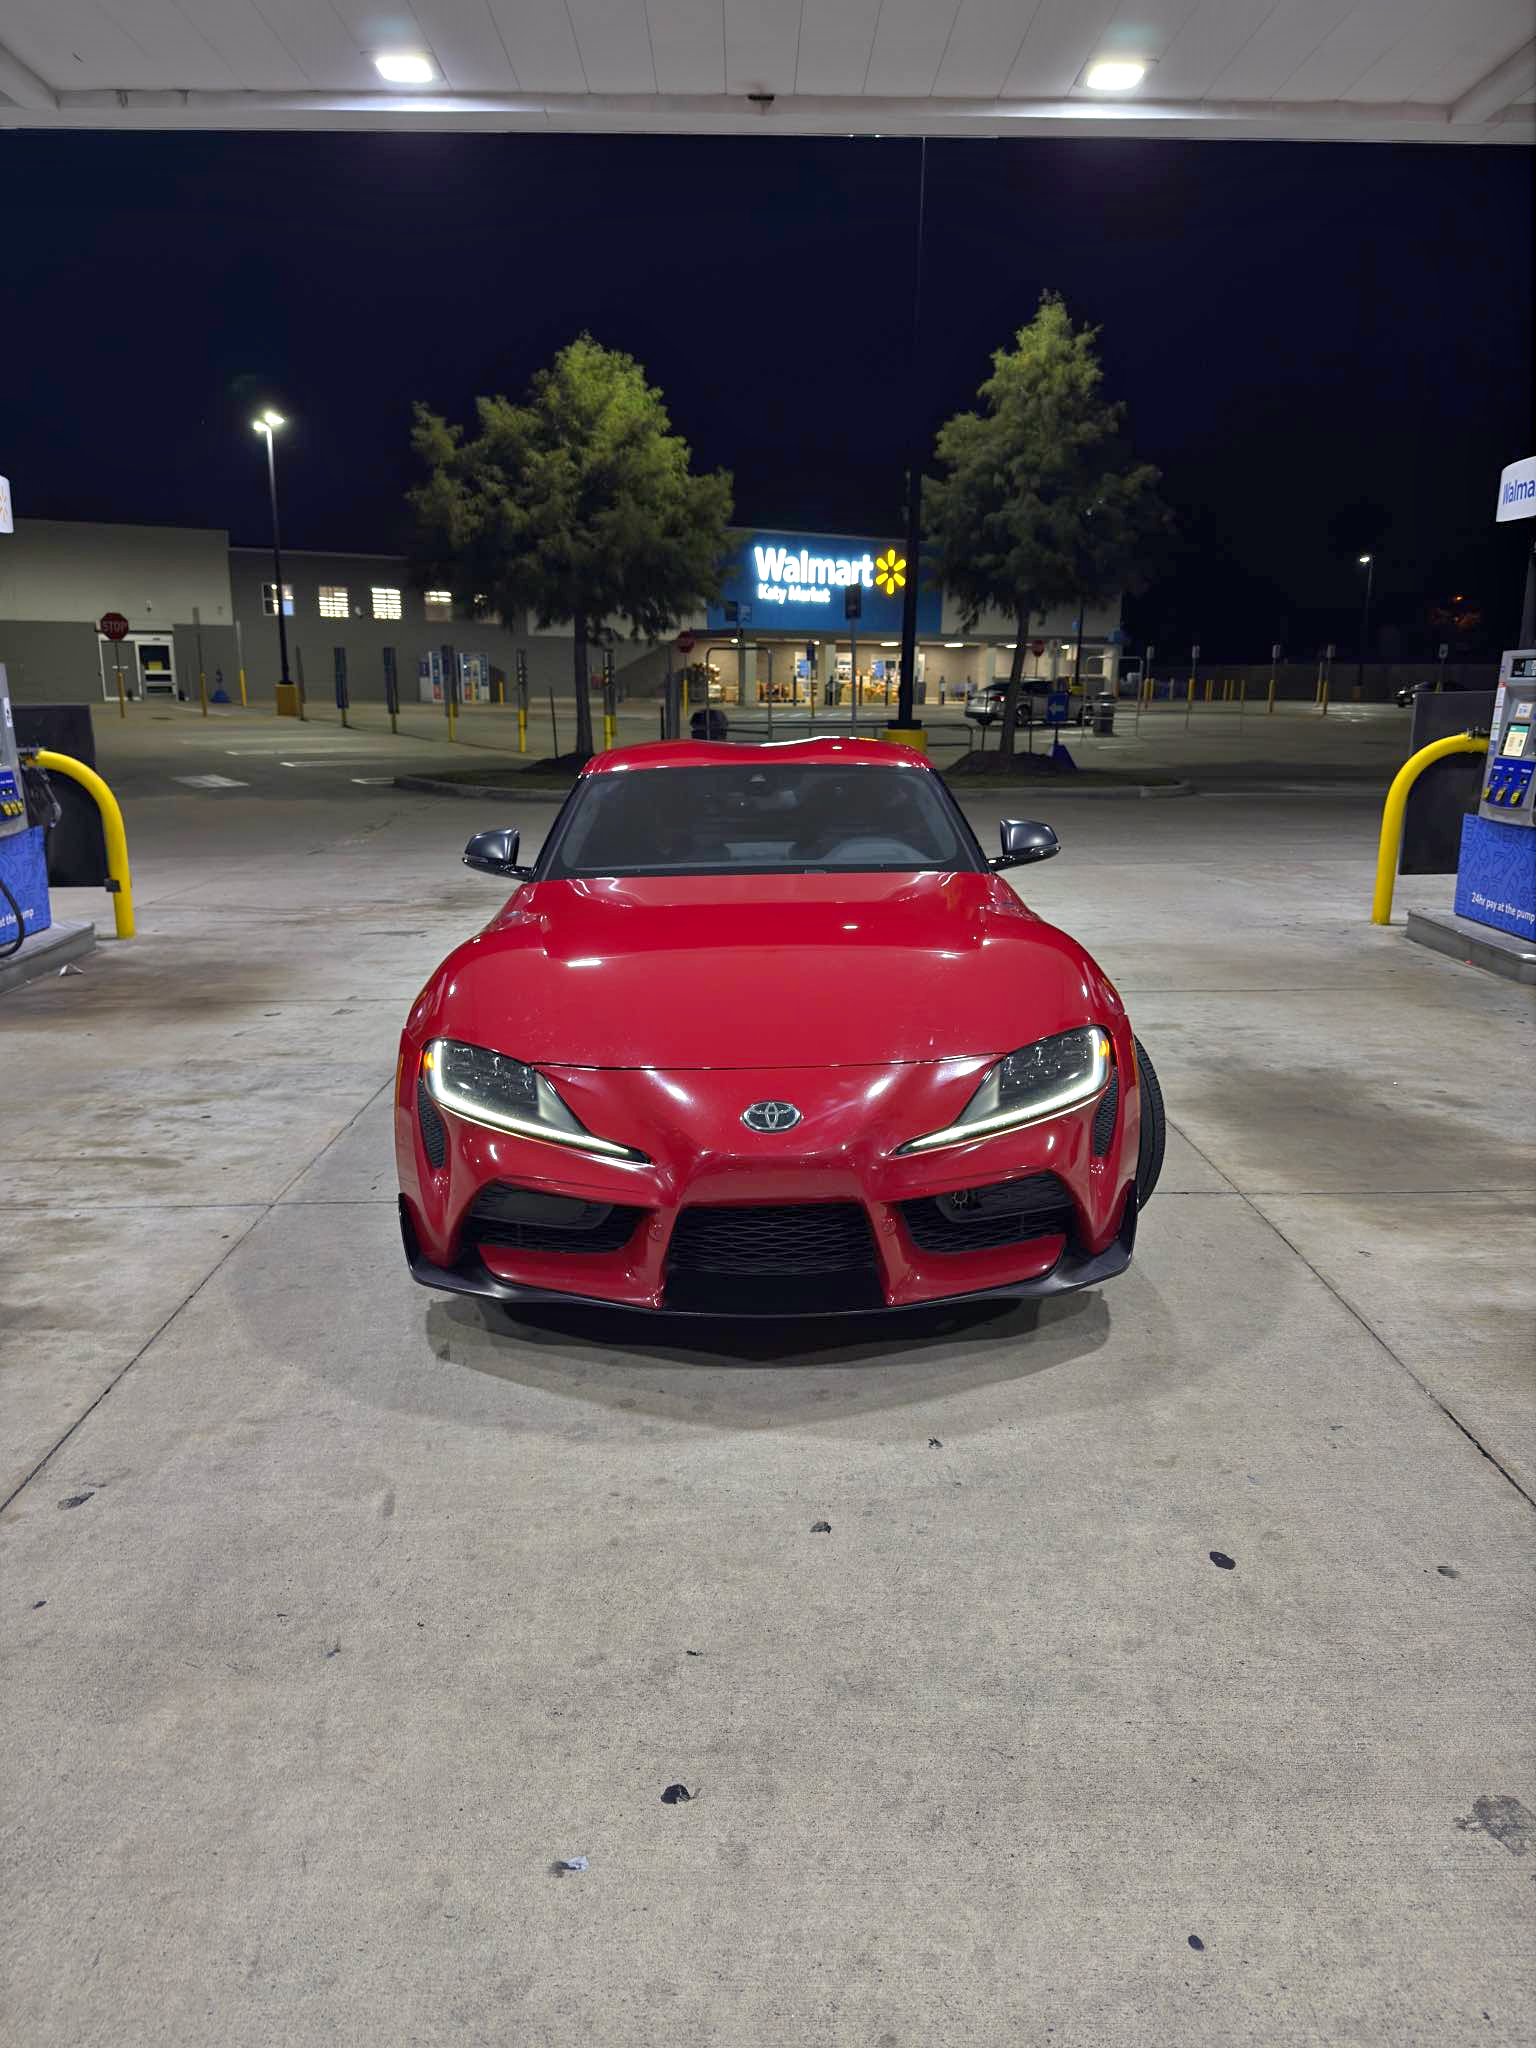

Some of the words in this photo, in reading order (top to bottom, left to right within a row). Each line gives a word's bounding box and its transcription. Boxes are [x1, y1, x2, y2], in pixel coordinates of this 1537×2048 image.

[753, 545, 874, 588] Walmart
[757, 583, 788, 605] Katy
[787, 584, 832, 603] Market
[102, 620, 128, 634] STOP
[1471, 891, 1486, 906] 24hr
[1485, 898, 1498, 912] pay
[1497, 902, 1505, 912] at
[1505, 903, 1516, 916] the
[1516, 908, 1536, 925] pump
